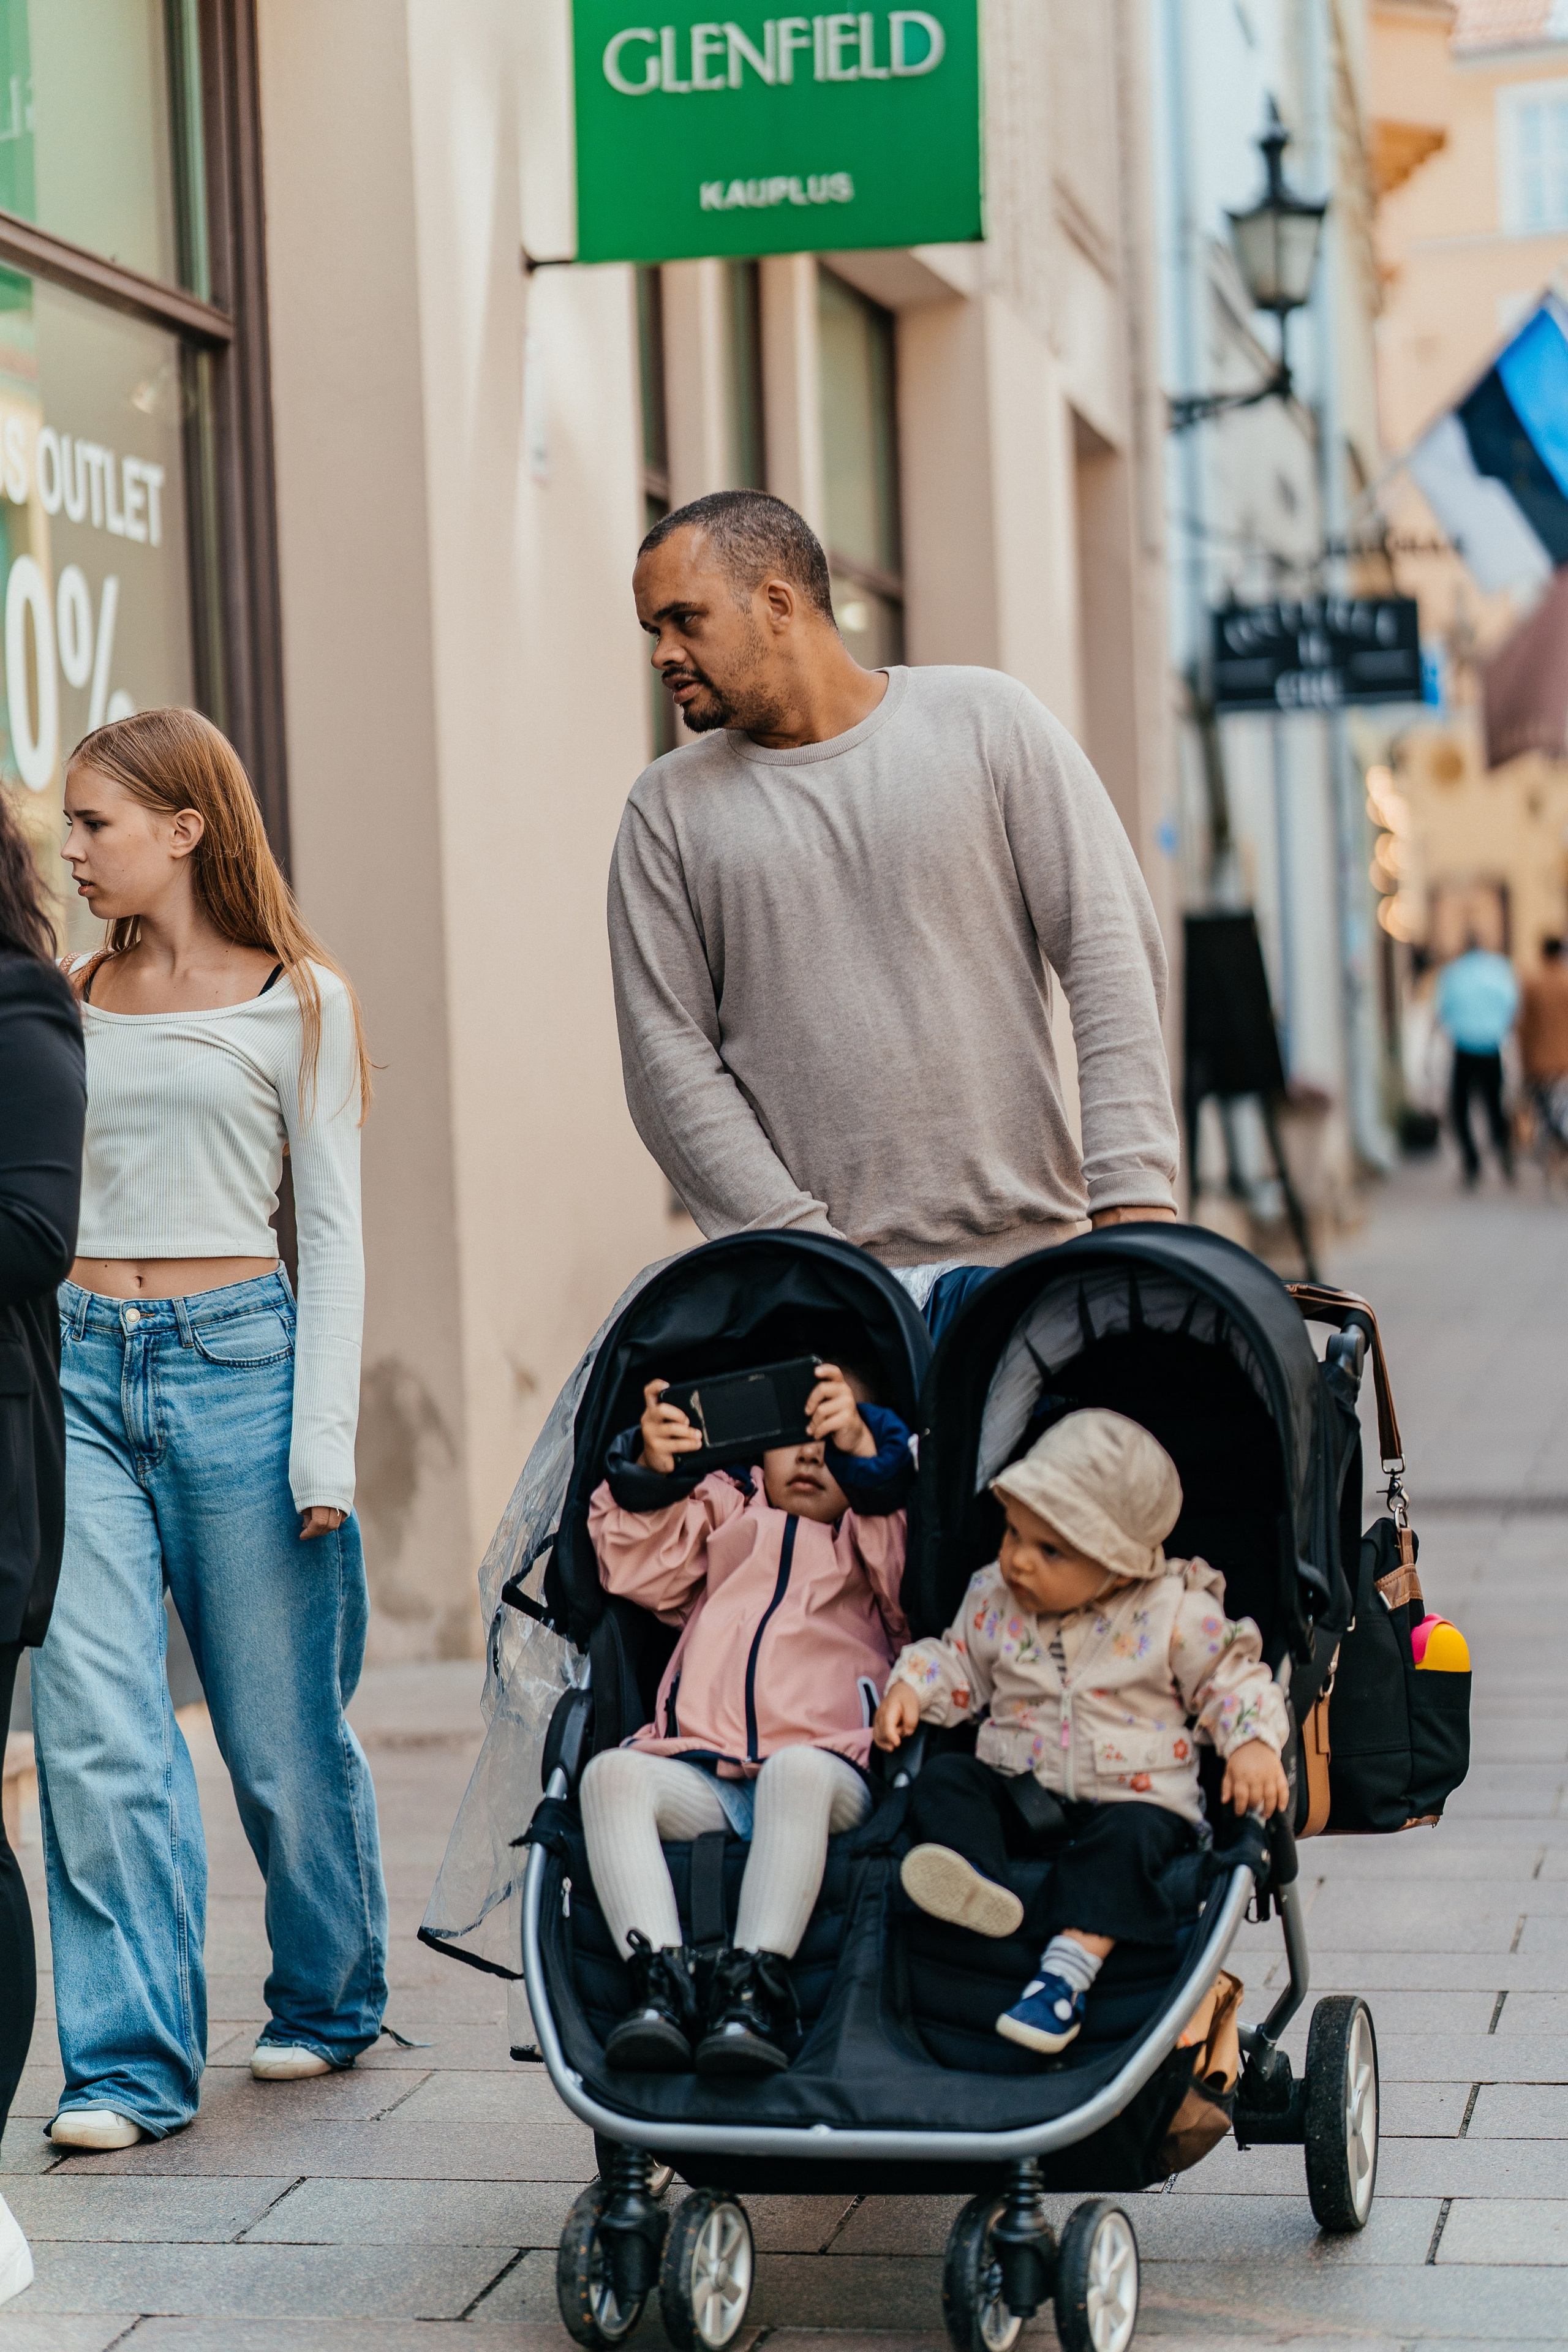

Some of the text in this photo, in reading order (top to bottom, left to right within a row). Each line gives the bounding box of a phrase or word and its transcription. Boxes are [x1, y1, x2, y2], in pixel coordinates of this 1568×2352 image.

[602, 10, 946, 96] GLENFIELD
[699, 172, 854, 210] KAUPLUS
[37, 426, 164, 546] OUTLET
